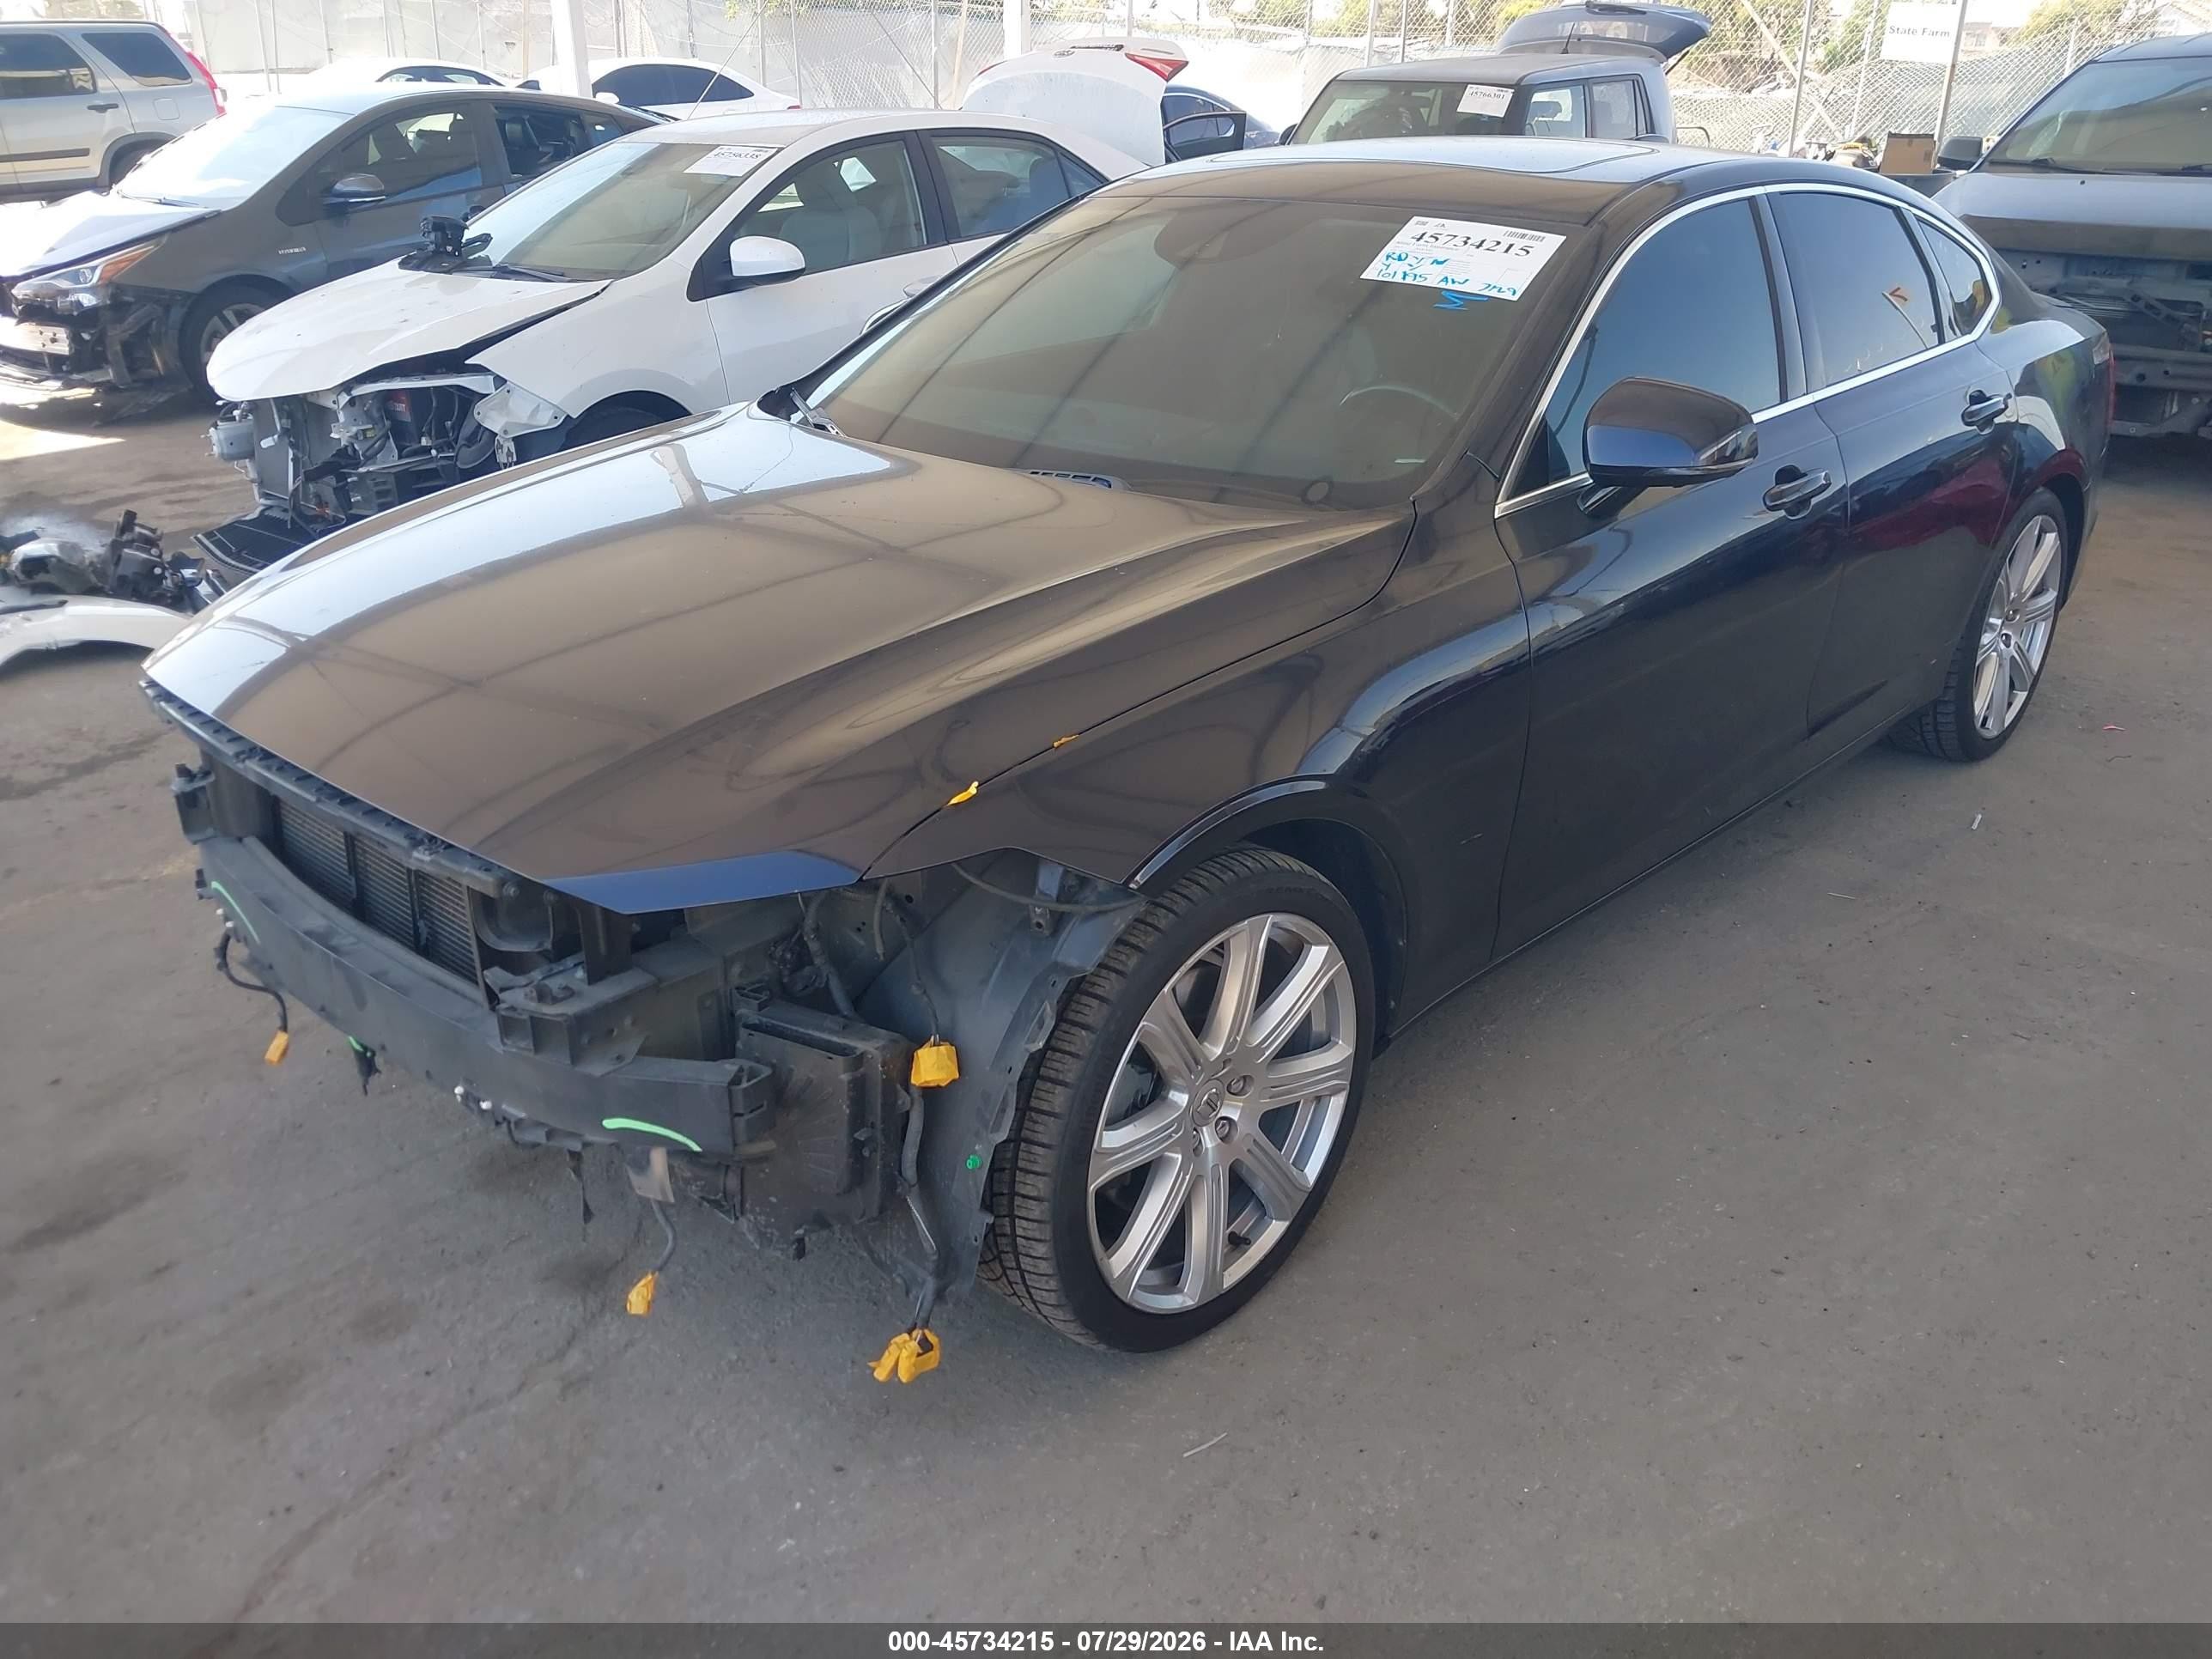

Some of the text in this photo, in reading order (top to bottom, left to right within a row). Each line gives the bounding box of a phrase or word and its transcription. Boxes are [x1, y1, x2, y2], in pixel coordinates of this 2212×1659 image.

[1888, 25, 1950, 38] State Farm
[1410, 230, 1535, 258] 45734215
